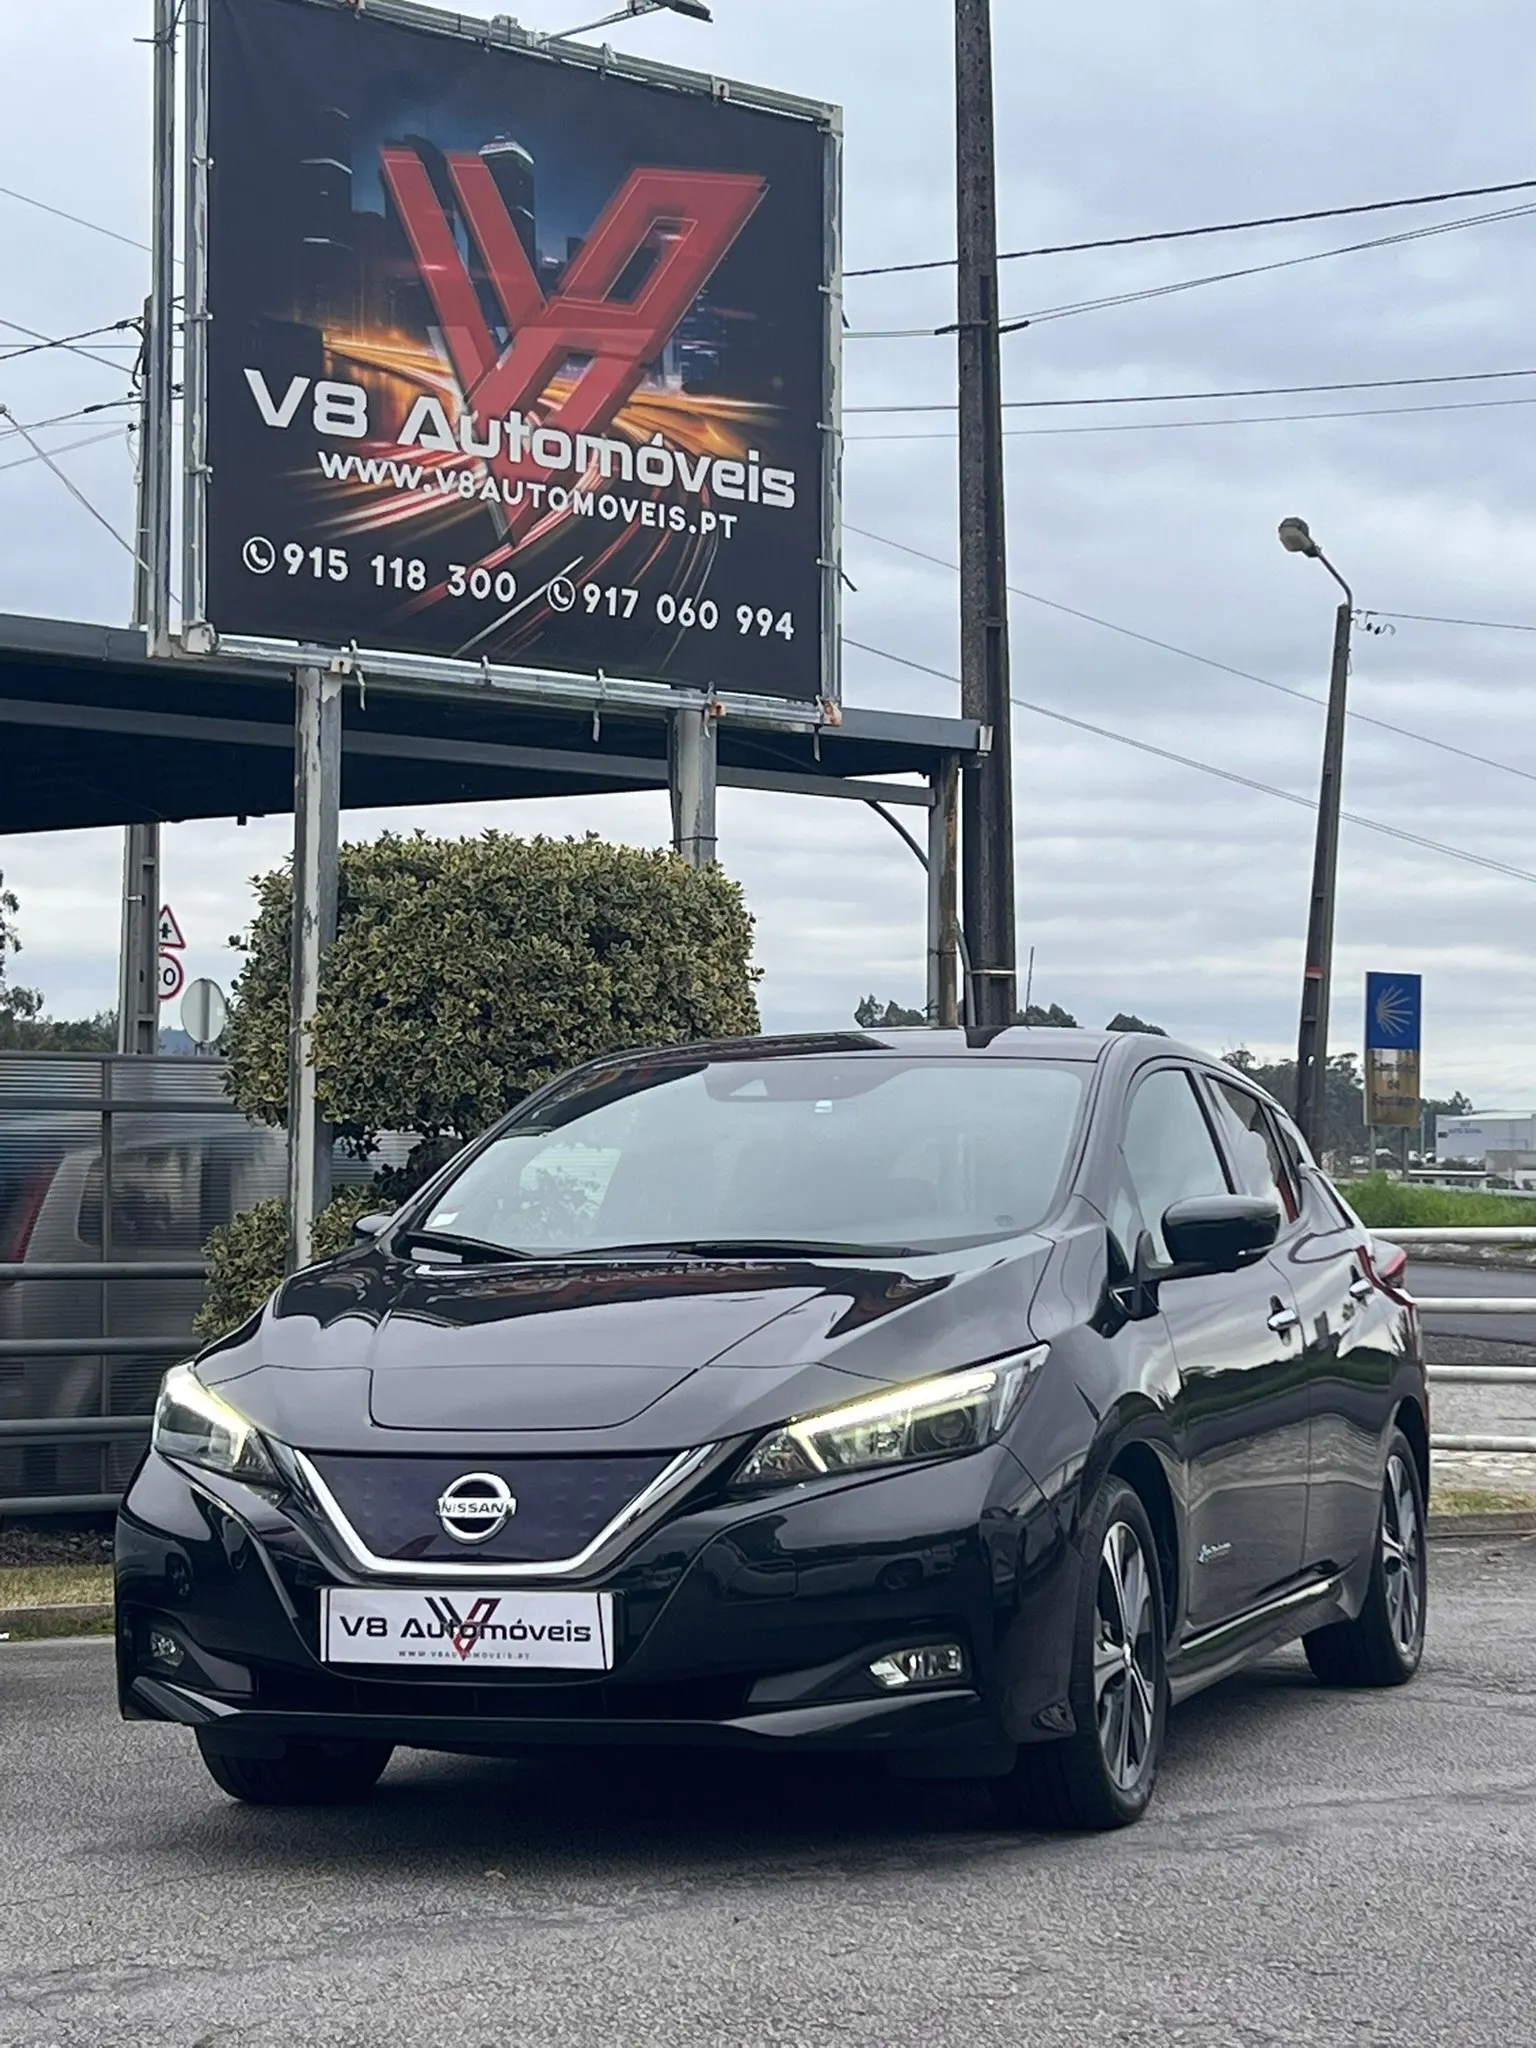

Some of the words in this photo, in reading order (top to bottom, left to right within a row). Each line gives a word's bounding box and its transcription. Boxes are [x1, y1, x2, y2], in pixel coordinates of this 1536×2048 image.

[243, 368, 368, 439] V8
[396, 395, 796, 510] Automóveis
[317, 450, 739, 540] WWW.V8AUTOMOVEIS.PT
[282, 543, 349, 582] 915
[370, 555, 427, 592] 118
[447, 564, 517, 603] 300
[583, 583, 638, 620] 917
[656, 597, 719, 632] 060
[736, 605, 795, 642] 994
[441, 1502, 504, 1513] NISSAN
[340, 1615, 388, 1638] V8
[400, 1616, 592, 1643] Automóveis
